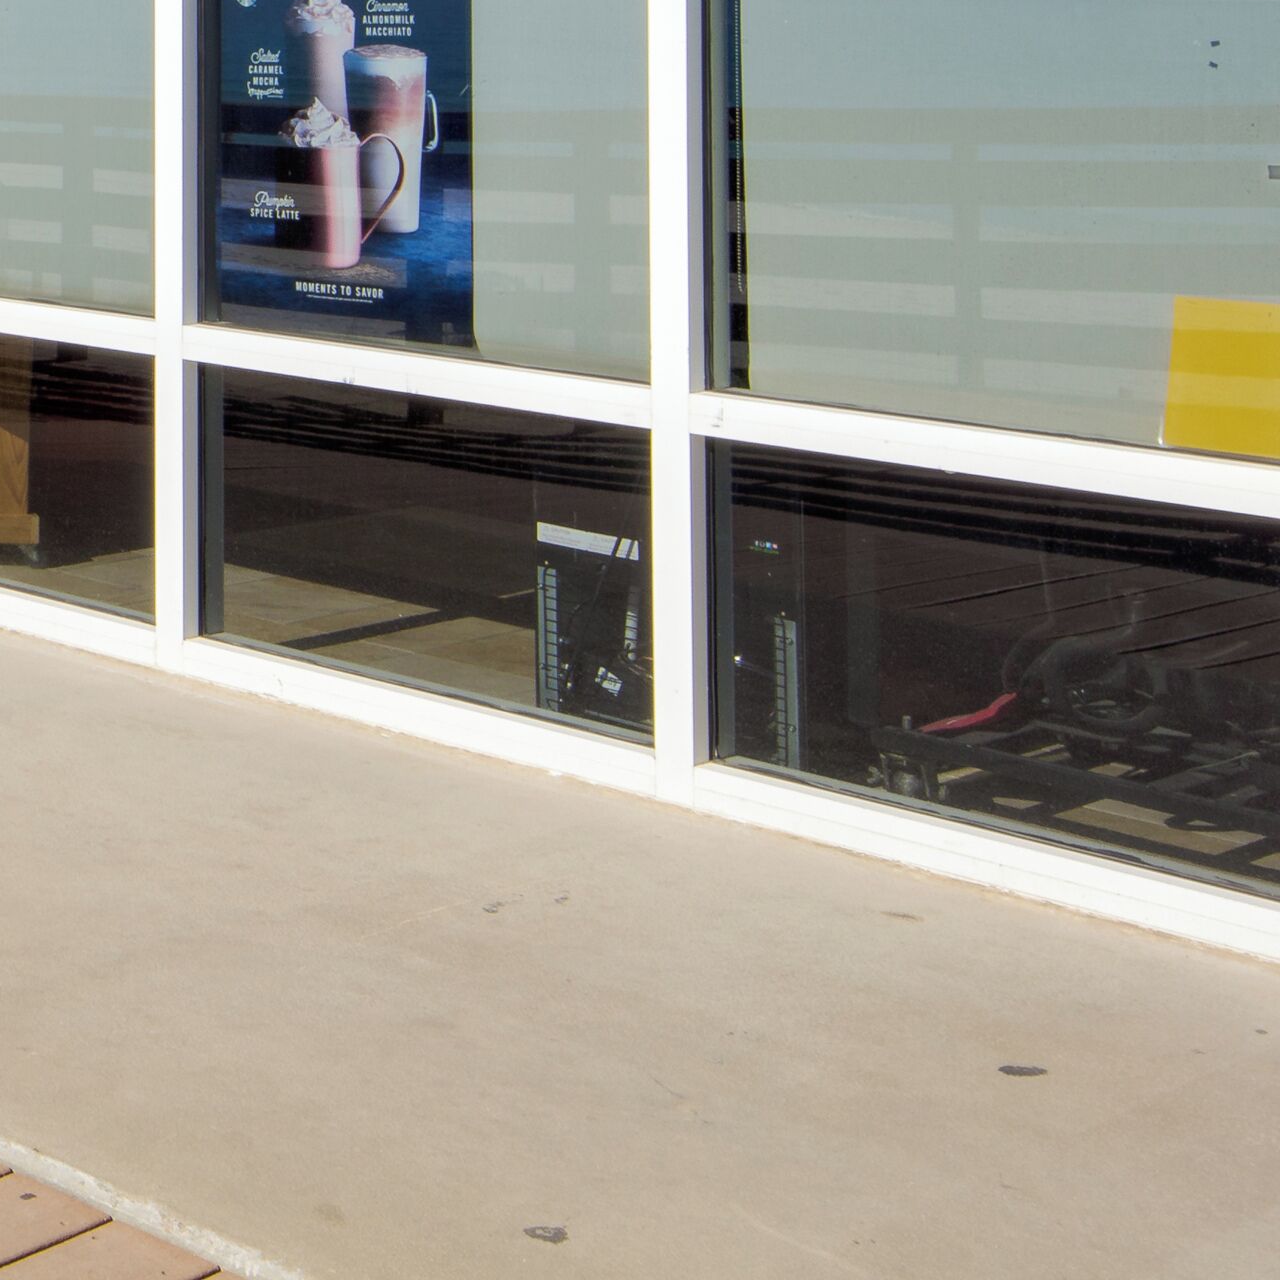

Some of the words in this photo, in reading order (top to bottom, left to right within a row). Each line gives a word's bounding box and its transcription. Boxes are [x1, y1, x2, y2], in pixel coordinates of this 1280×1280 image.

[362, 15, 416, 25] ALMONDMILK
[365, 26, 412, 37] MACCHIATO
[248, 64, 284, 75] CARAMEL
[252, 76, 280, 86] MOCHA
[250, 207, 274, 218] SPICE
[276, 210, 301, 220] LATTE
[295, 281, 338, 295] MOMENTS
[340, 285, 353, 296] TO
[355, 286, 385, 299] SAVOR
